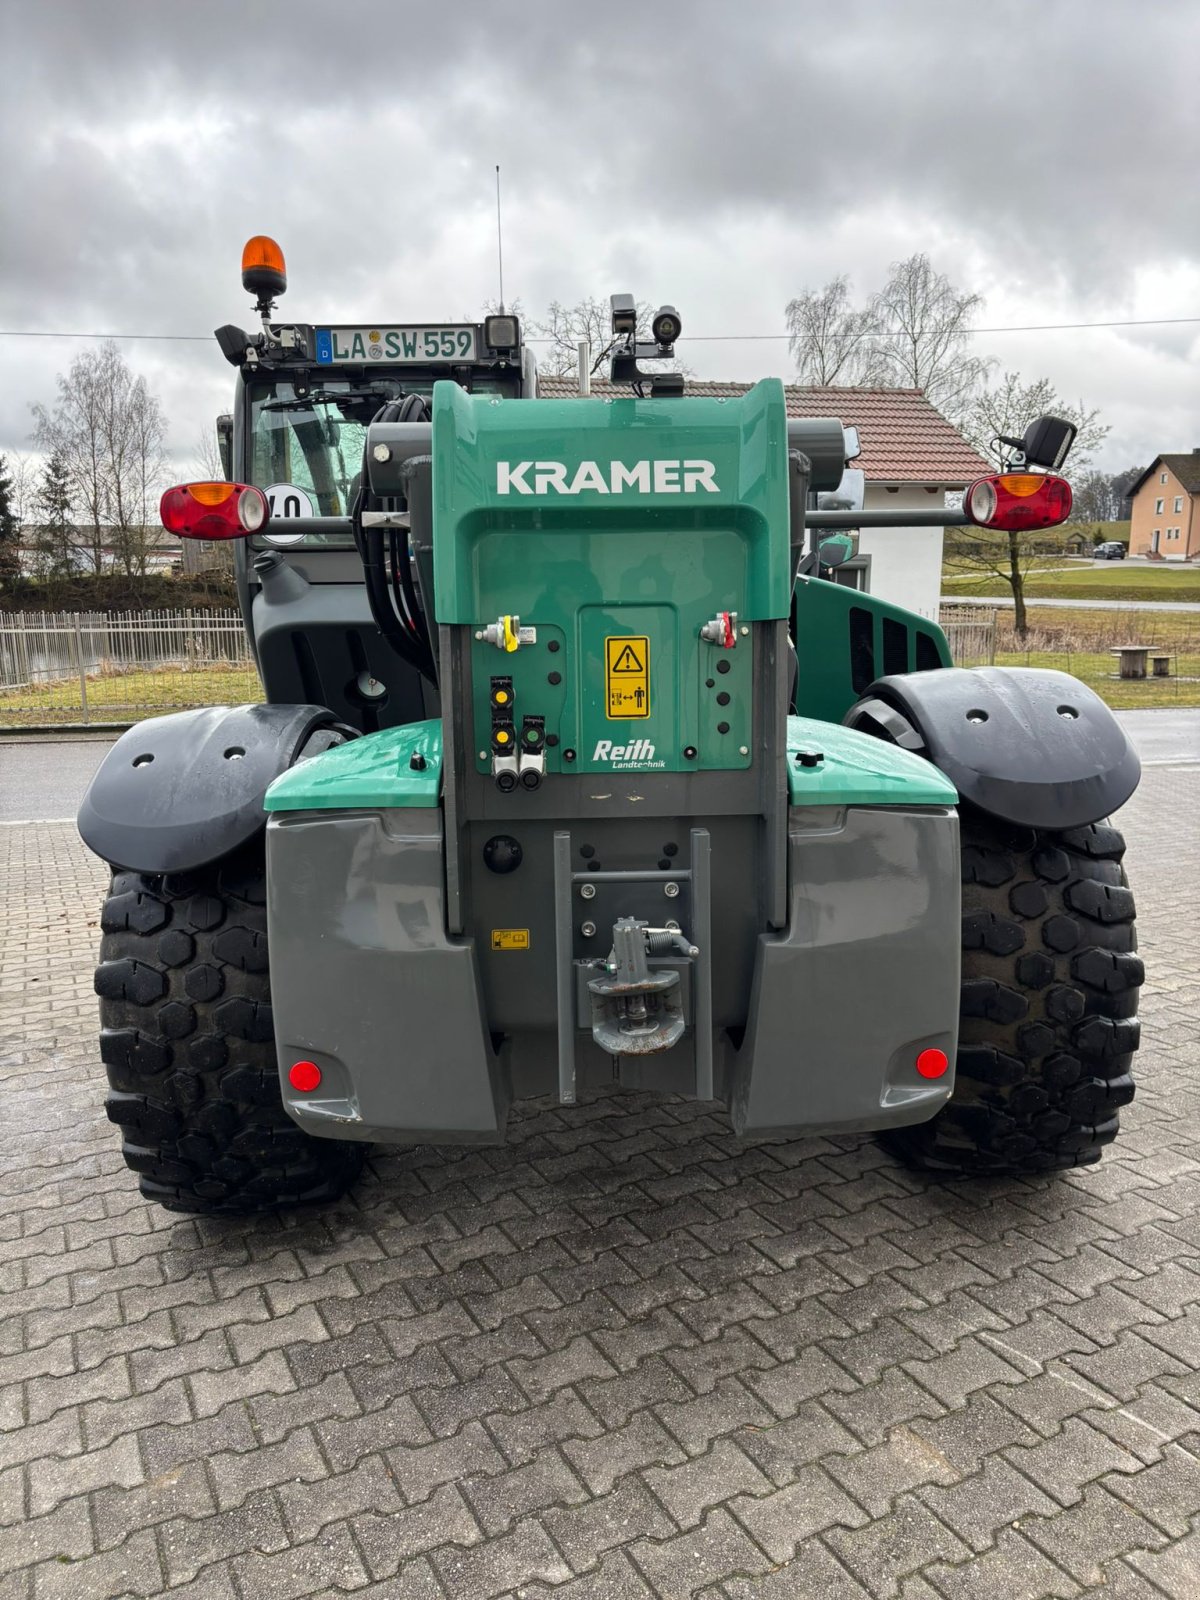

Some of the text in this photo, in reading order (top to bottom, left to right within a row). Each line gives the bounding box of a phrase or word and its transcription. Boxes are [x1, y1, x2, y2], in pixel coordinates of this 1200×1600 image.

[322, 331, 472, 359] D LA SW 559
[496, 460, 721, 494] KRAMER
[592, 739, 656, 761] Reith
